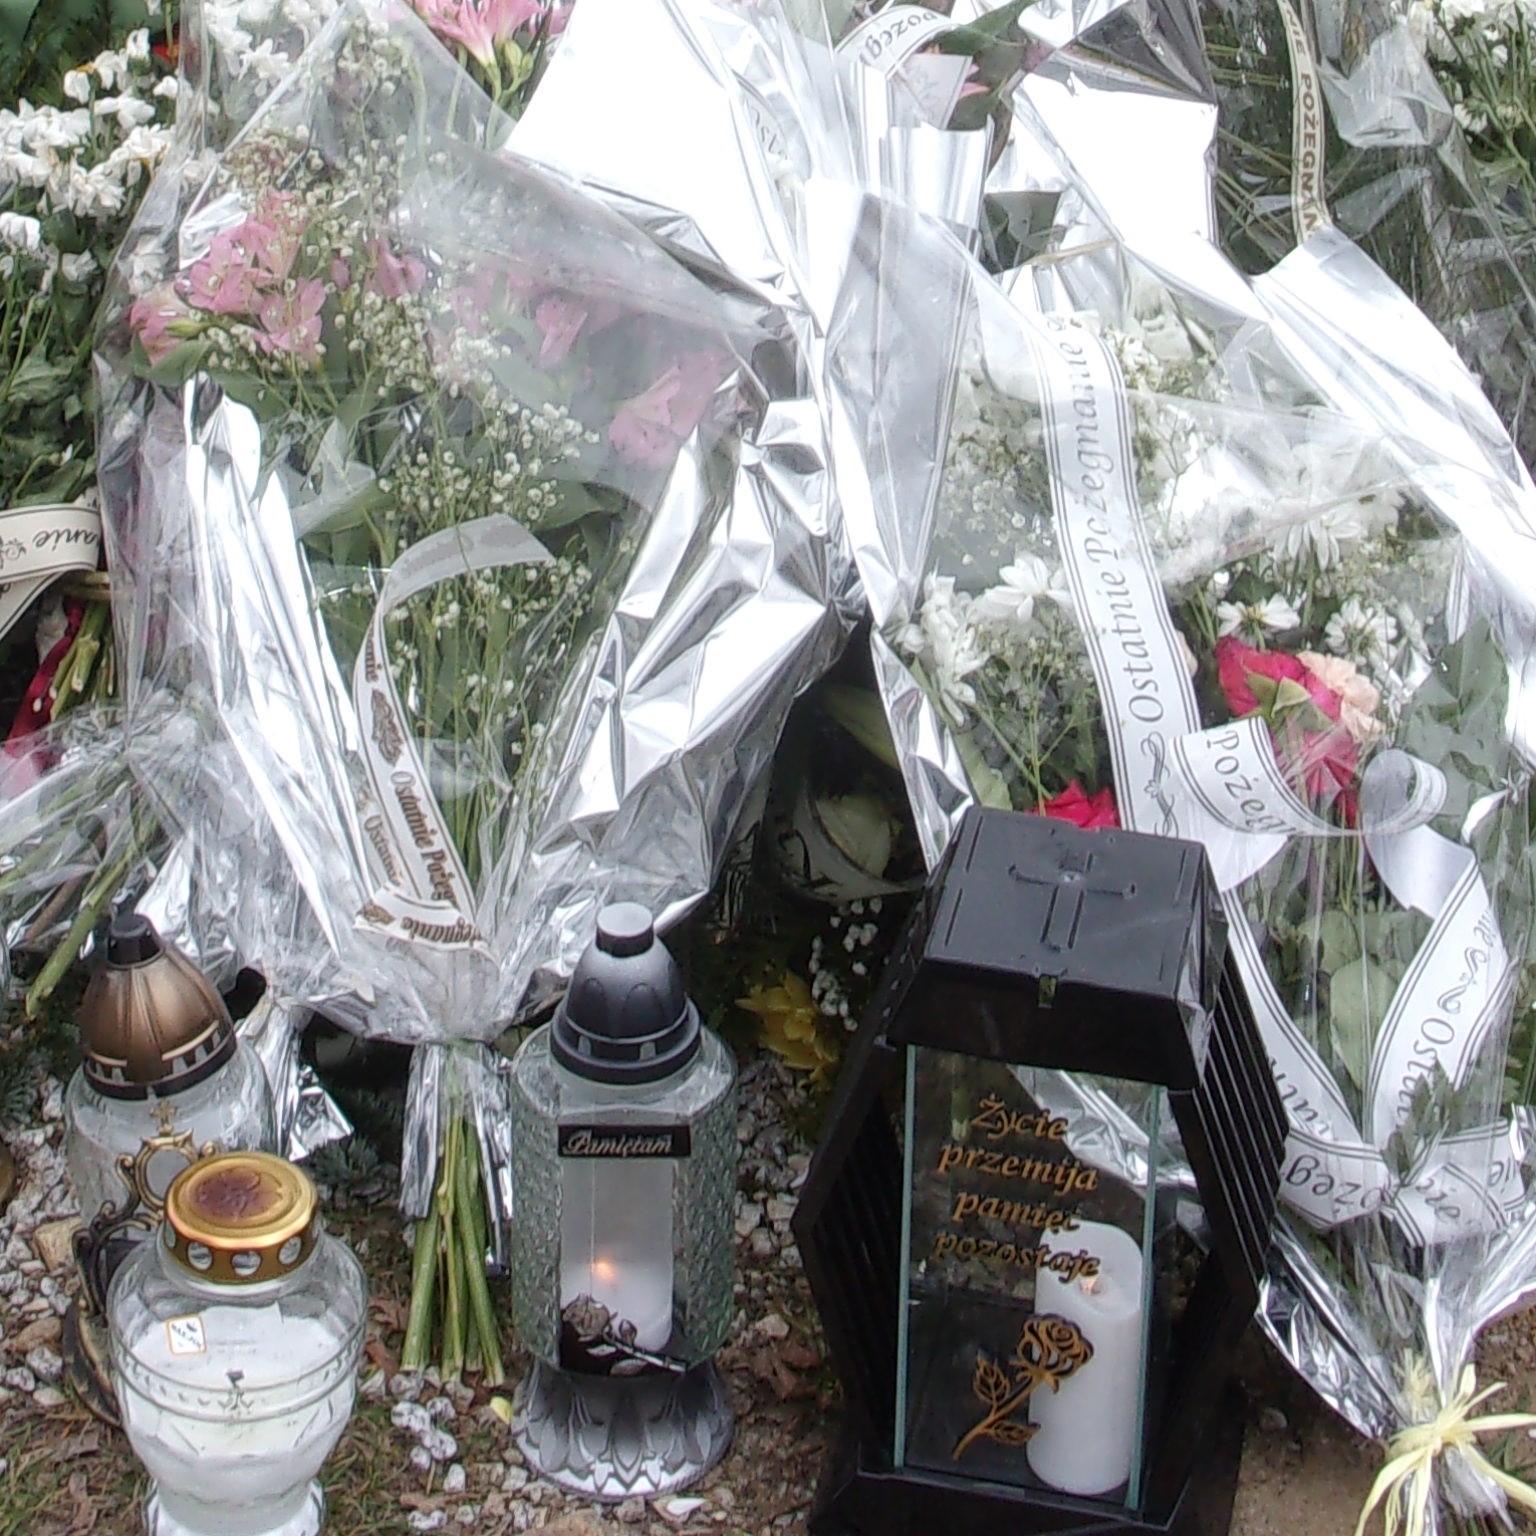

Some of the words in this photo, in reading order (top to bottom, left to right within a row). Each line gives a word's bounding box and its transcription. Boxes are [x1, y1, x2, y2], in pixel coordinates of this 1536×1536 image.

[1096, 571, 1165, 725] Ostatnie
[971, 1092, 1070, 1141] Życie
[562, 1128, 673, 1158] Pamiętam
[937, 1143, 1100, 1198] przemija
[952, 1191, 1081, 1234] pamięć
[932, 1230, 1103, 1285] pozostaje
